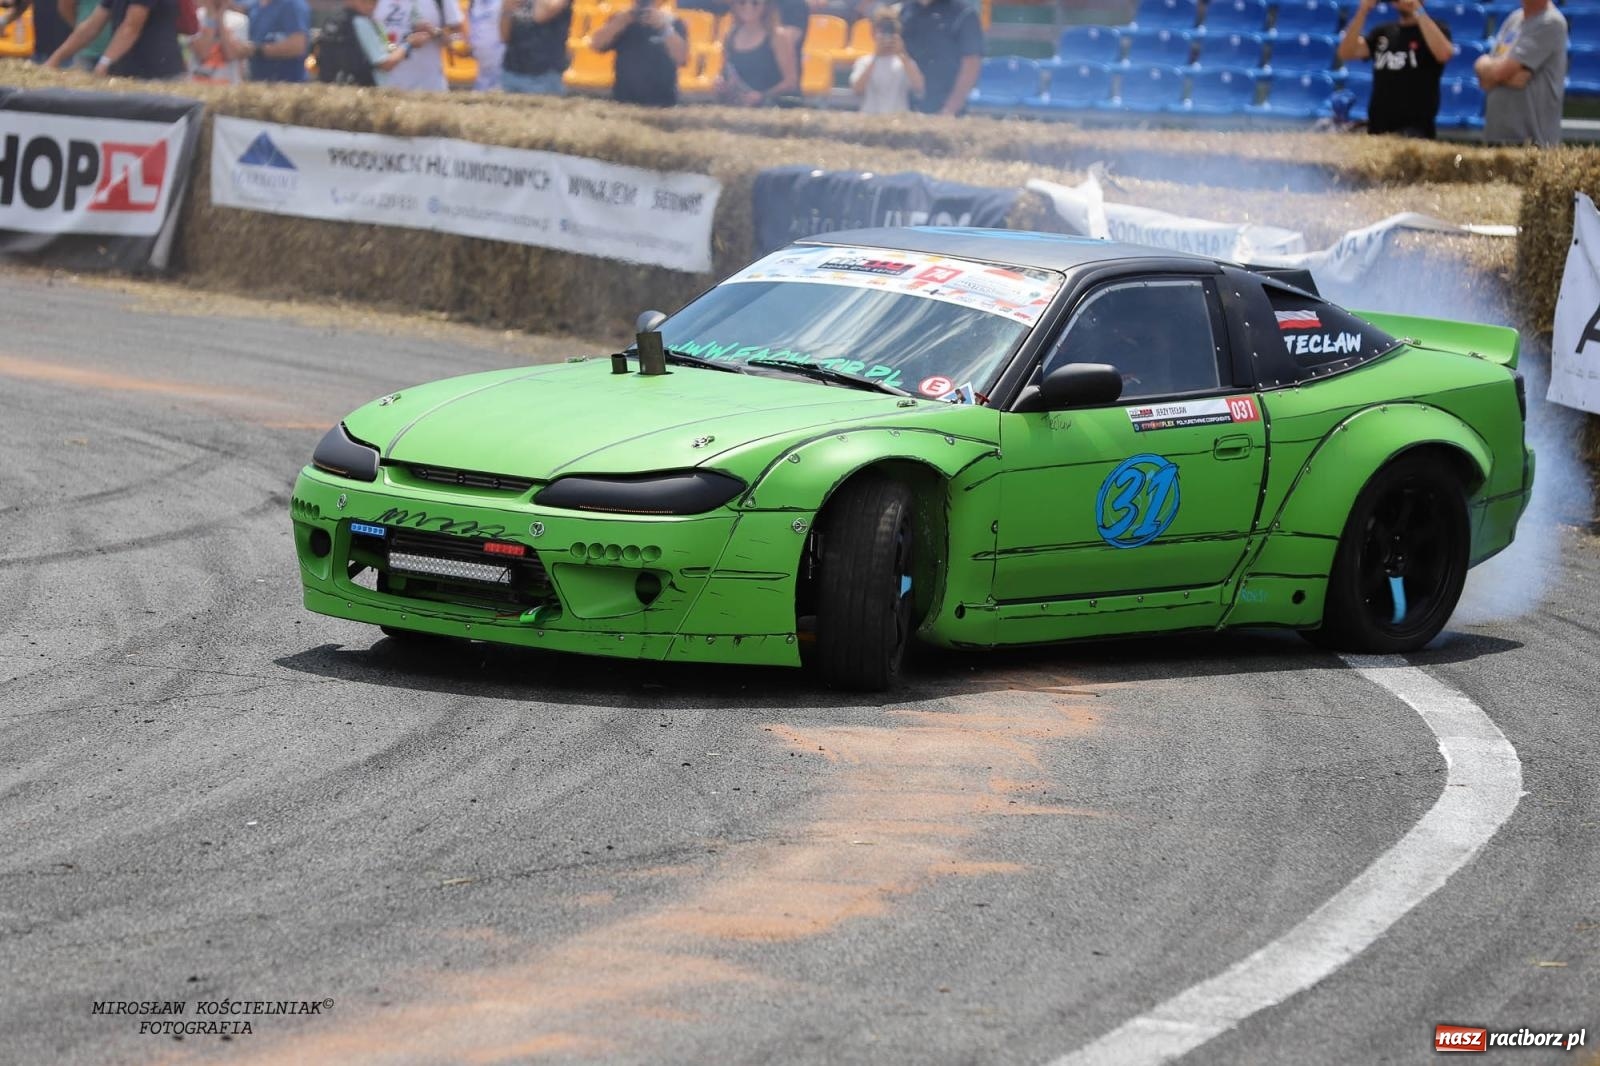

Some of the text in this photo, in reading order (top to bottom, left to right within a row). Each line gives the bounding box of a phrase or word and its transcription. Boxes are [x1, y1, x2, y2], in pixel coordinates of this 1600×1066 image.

[1284, 331, 1362, 355] TECŁAW
[1230, 399, 1255, 421] 031
[1099, 462, 1180, 541] 31
